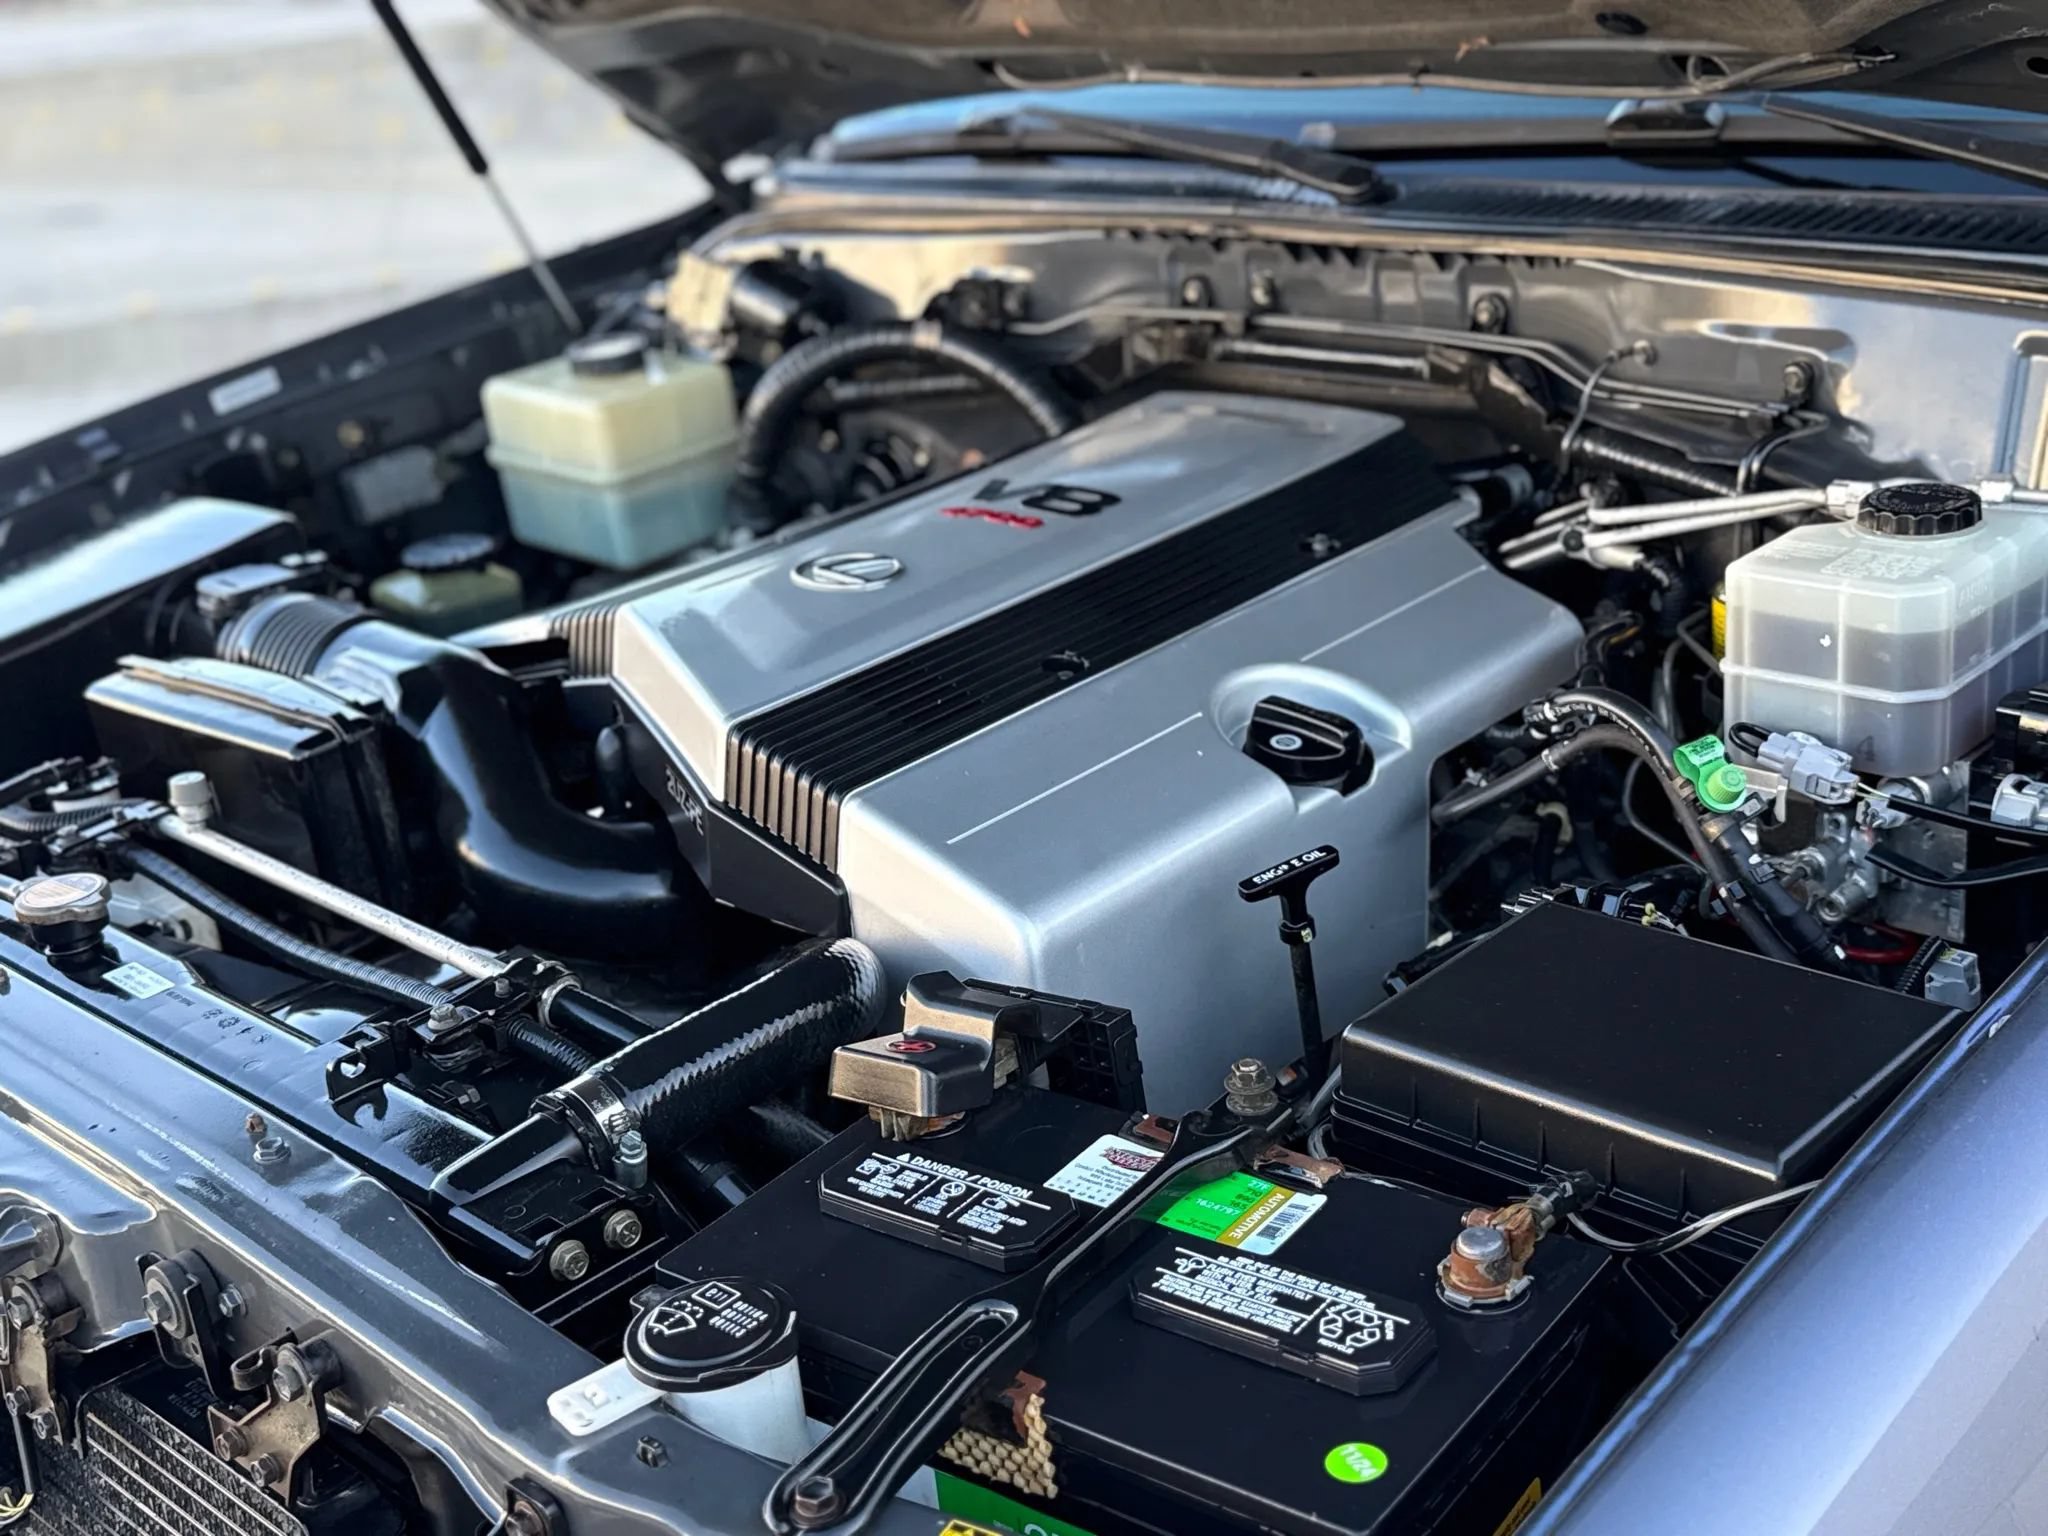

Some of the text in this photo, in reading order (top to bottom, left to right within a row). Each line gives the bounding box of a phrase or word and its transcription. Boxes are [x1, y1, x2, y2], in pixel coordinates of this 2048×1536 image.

[974, 479, 1122, 517] V8
[1302, 849, 1327, 862] OIL
[911, 1156, 969, 1178] DANGER
[977, 1176, 1034, 1199] POISON
[1229, 1192, 1286, 1239] AUTOMOTIVE
[1252, 1293, 1278, 1304] FAST
